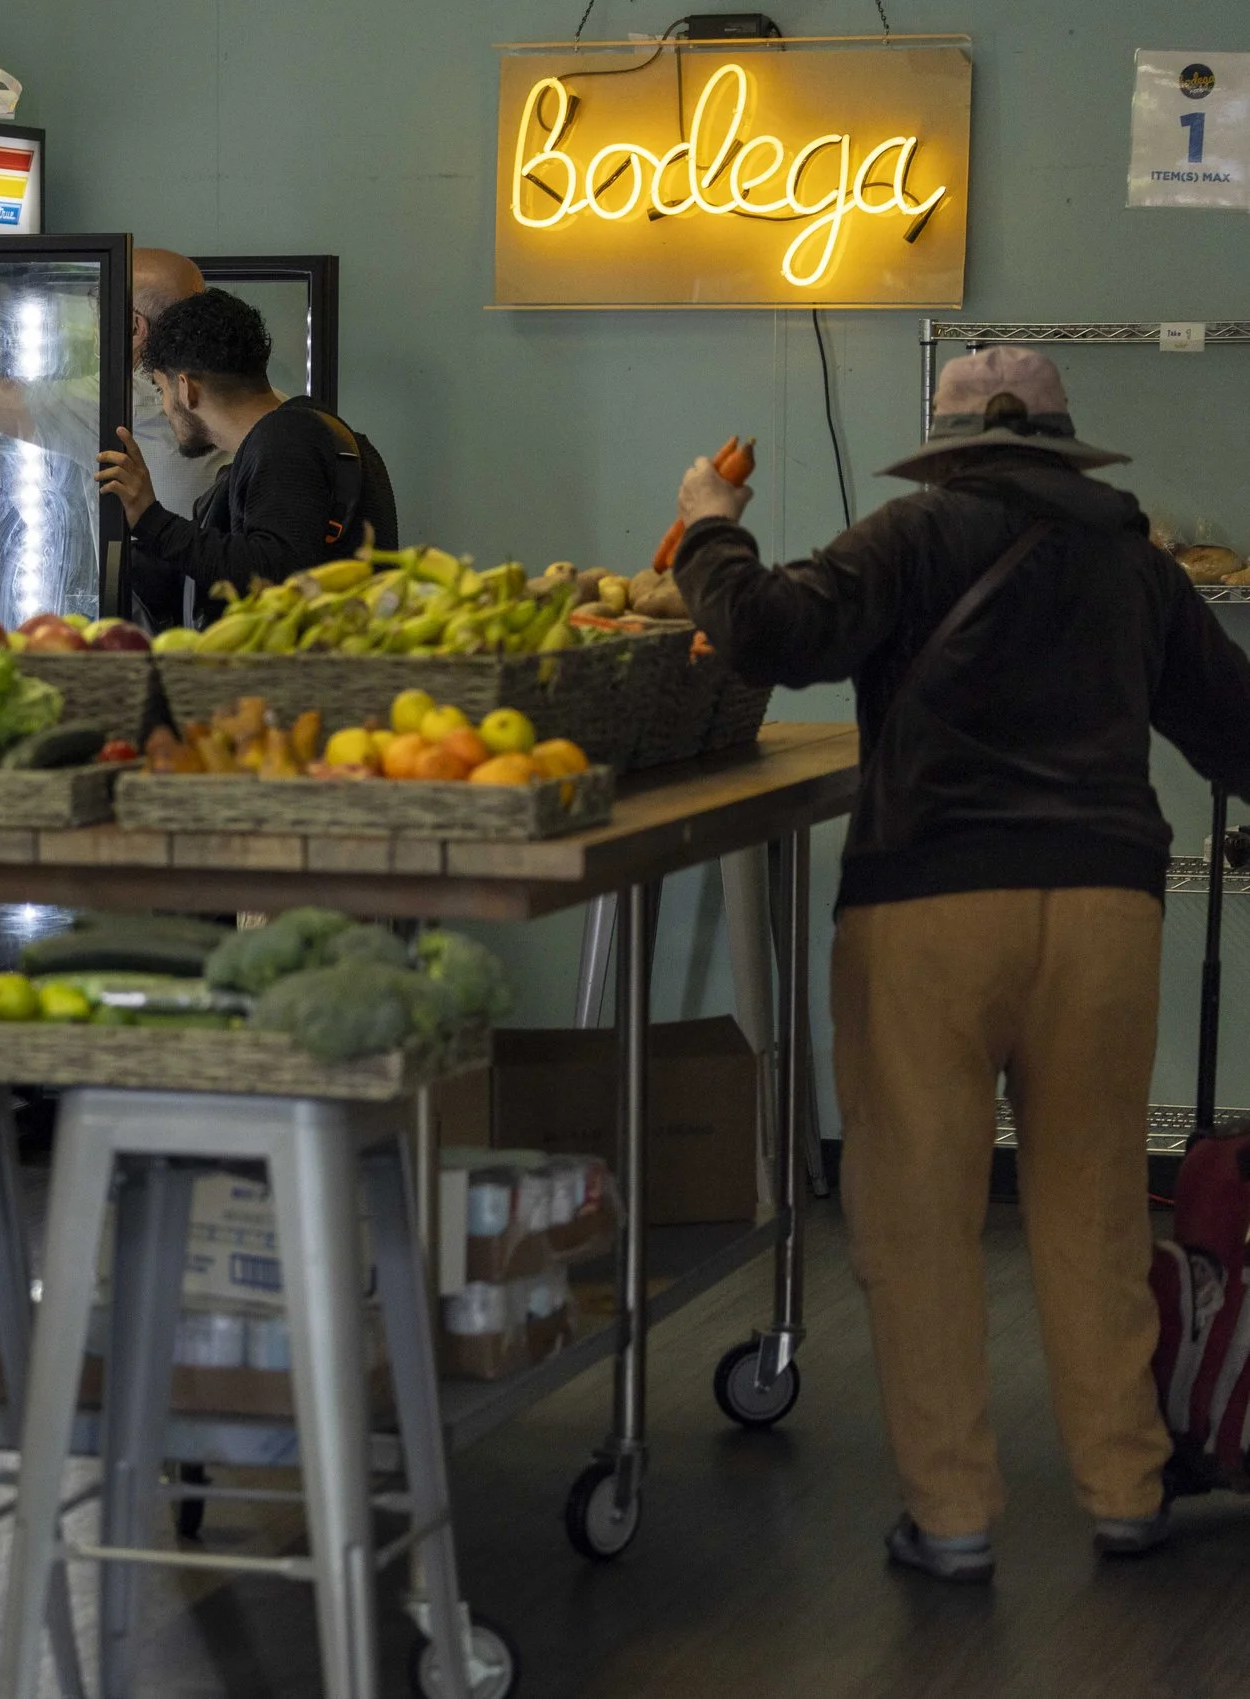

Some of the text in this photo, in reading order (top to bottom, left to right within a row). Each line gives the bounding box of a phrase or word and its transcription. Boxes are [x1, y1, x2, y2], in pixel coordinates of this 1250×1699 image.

[1180, 112, 1205, 163] 1
[511, 63, 947, 287] bodega
[1151, 171, 1231, 183] ITEM(S) MAX
